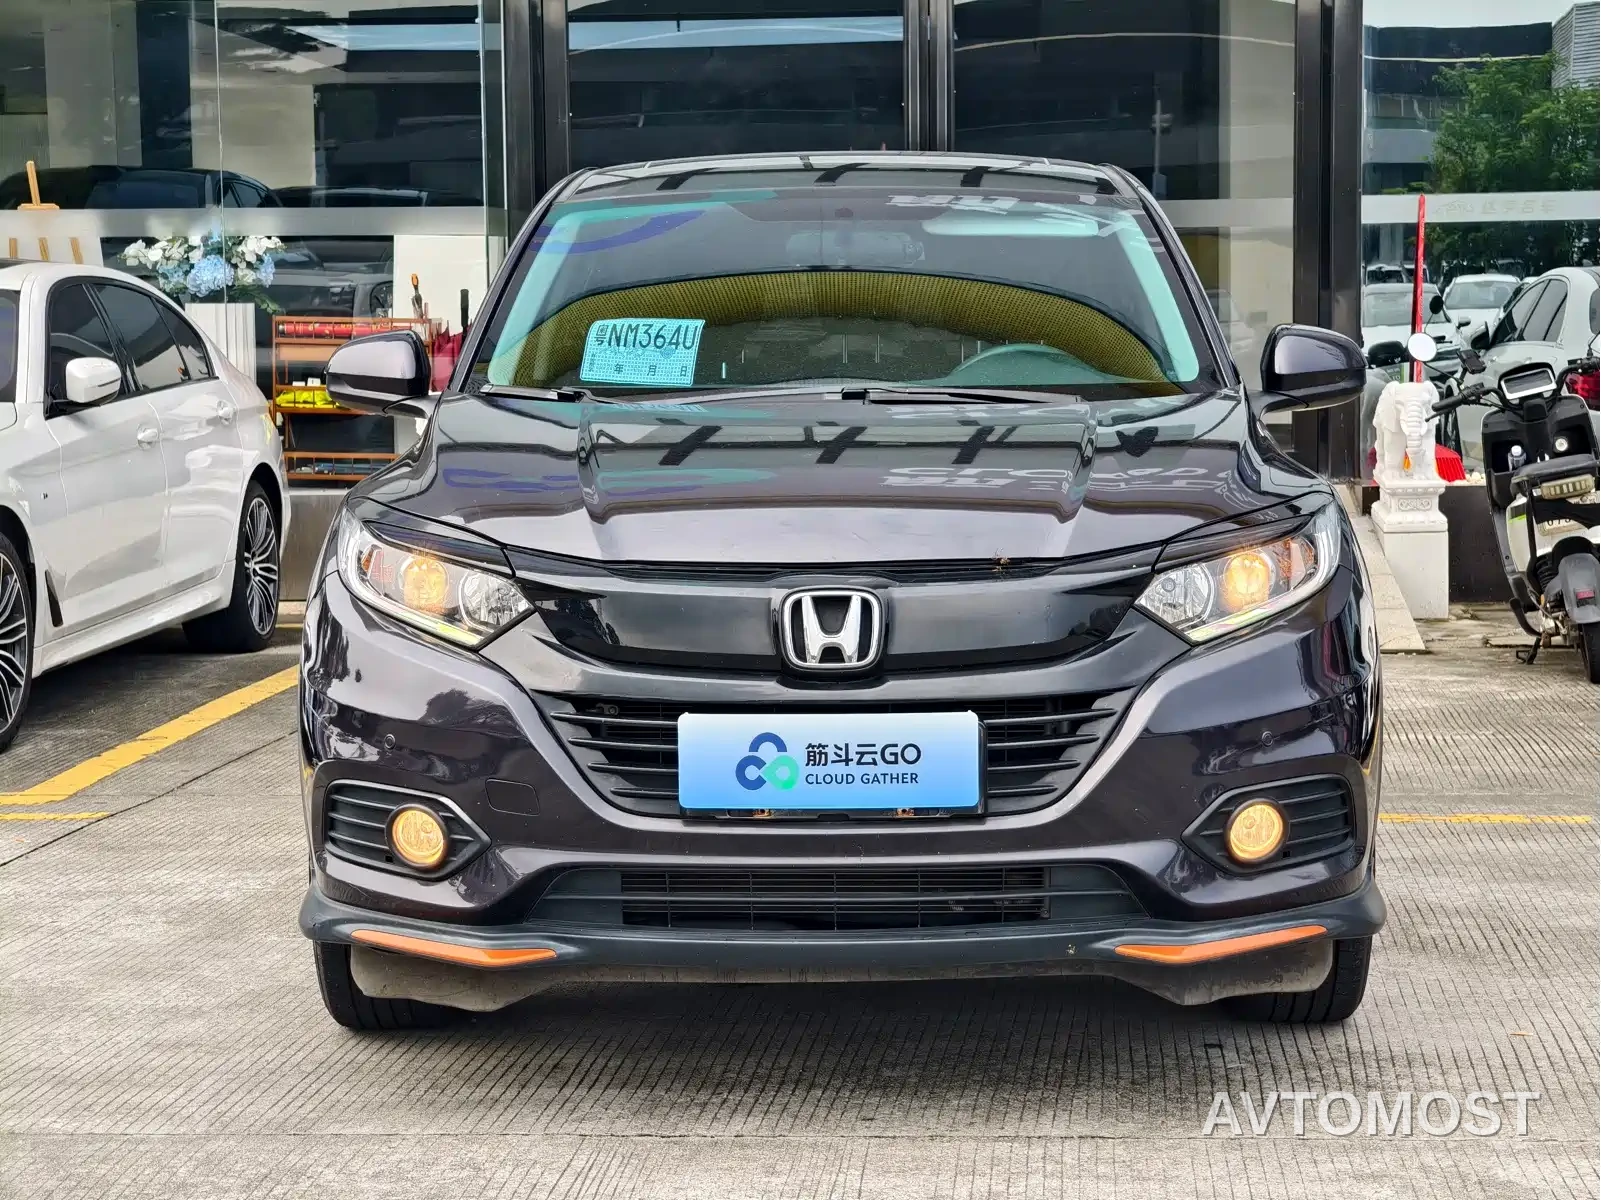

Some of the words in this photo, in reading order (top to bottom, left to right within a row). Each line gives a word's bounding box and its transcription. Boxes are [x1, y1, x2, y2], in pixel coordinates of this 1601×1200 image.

[614, 363, 624, 374] 年
[647, 365, 657, 376] 月
[680, 366, 688, 377] 日
[801, 592, 862, 664] H
[805, 743, 921, 766] 筋斗云GO
[805, 773, 855, 785] CLOUD
[861, 772, 919, 785] GATHER
